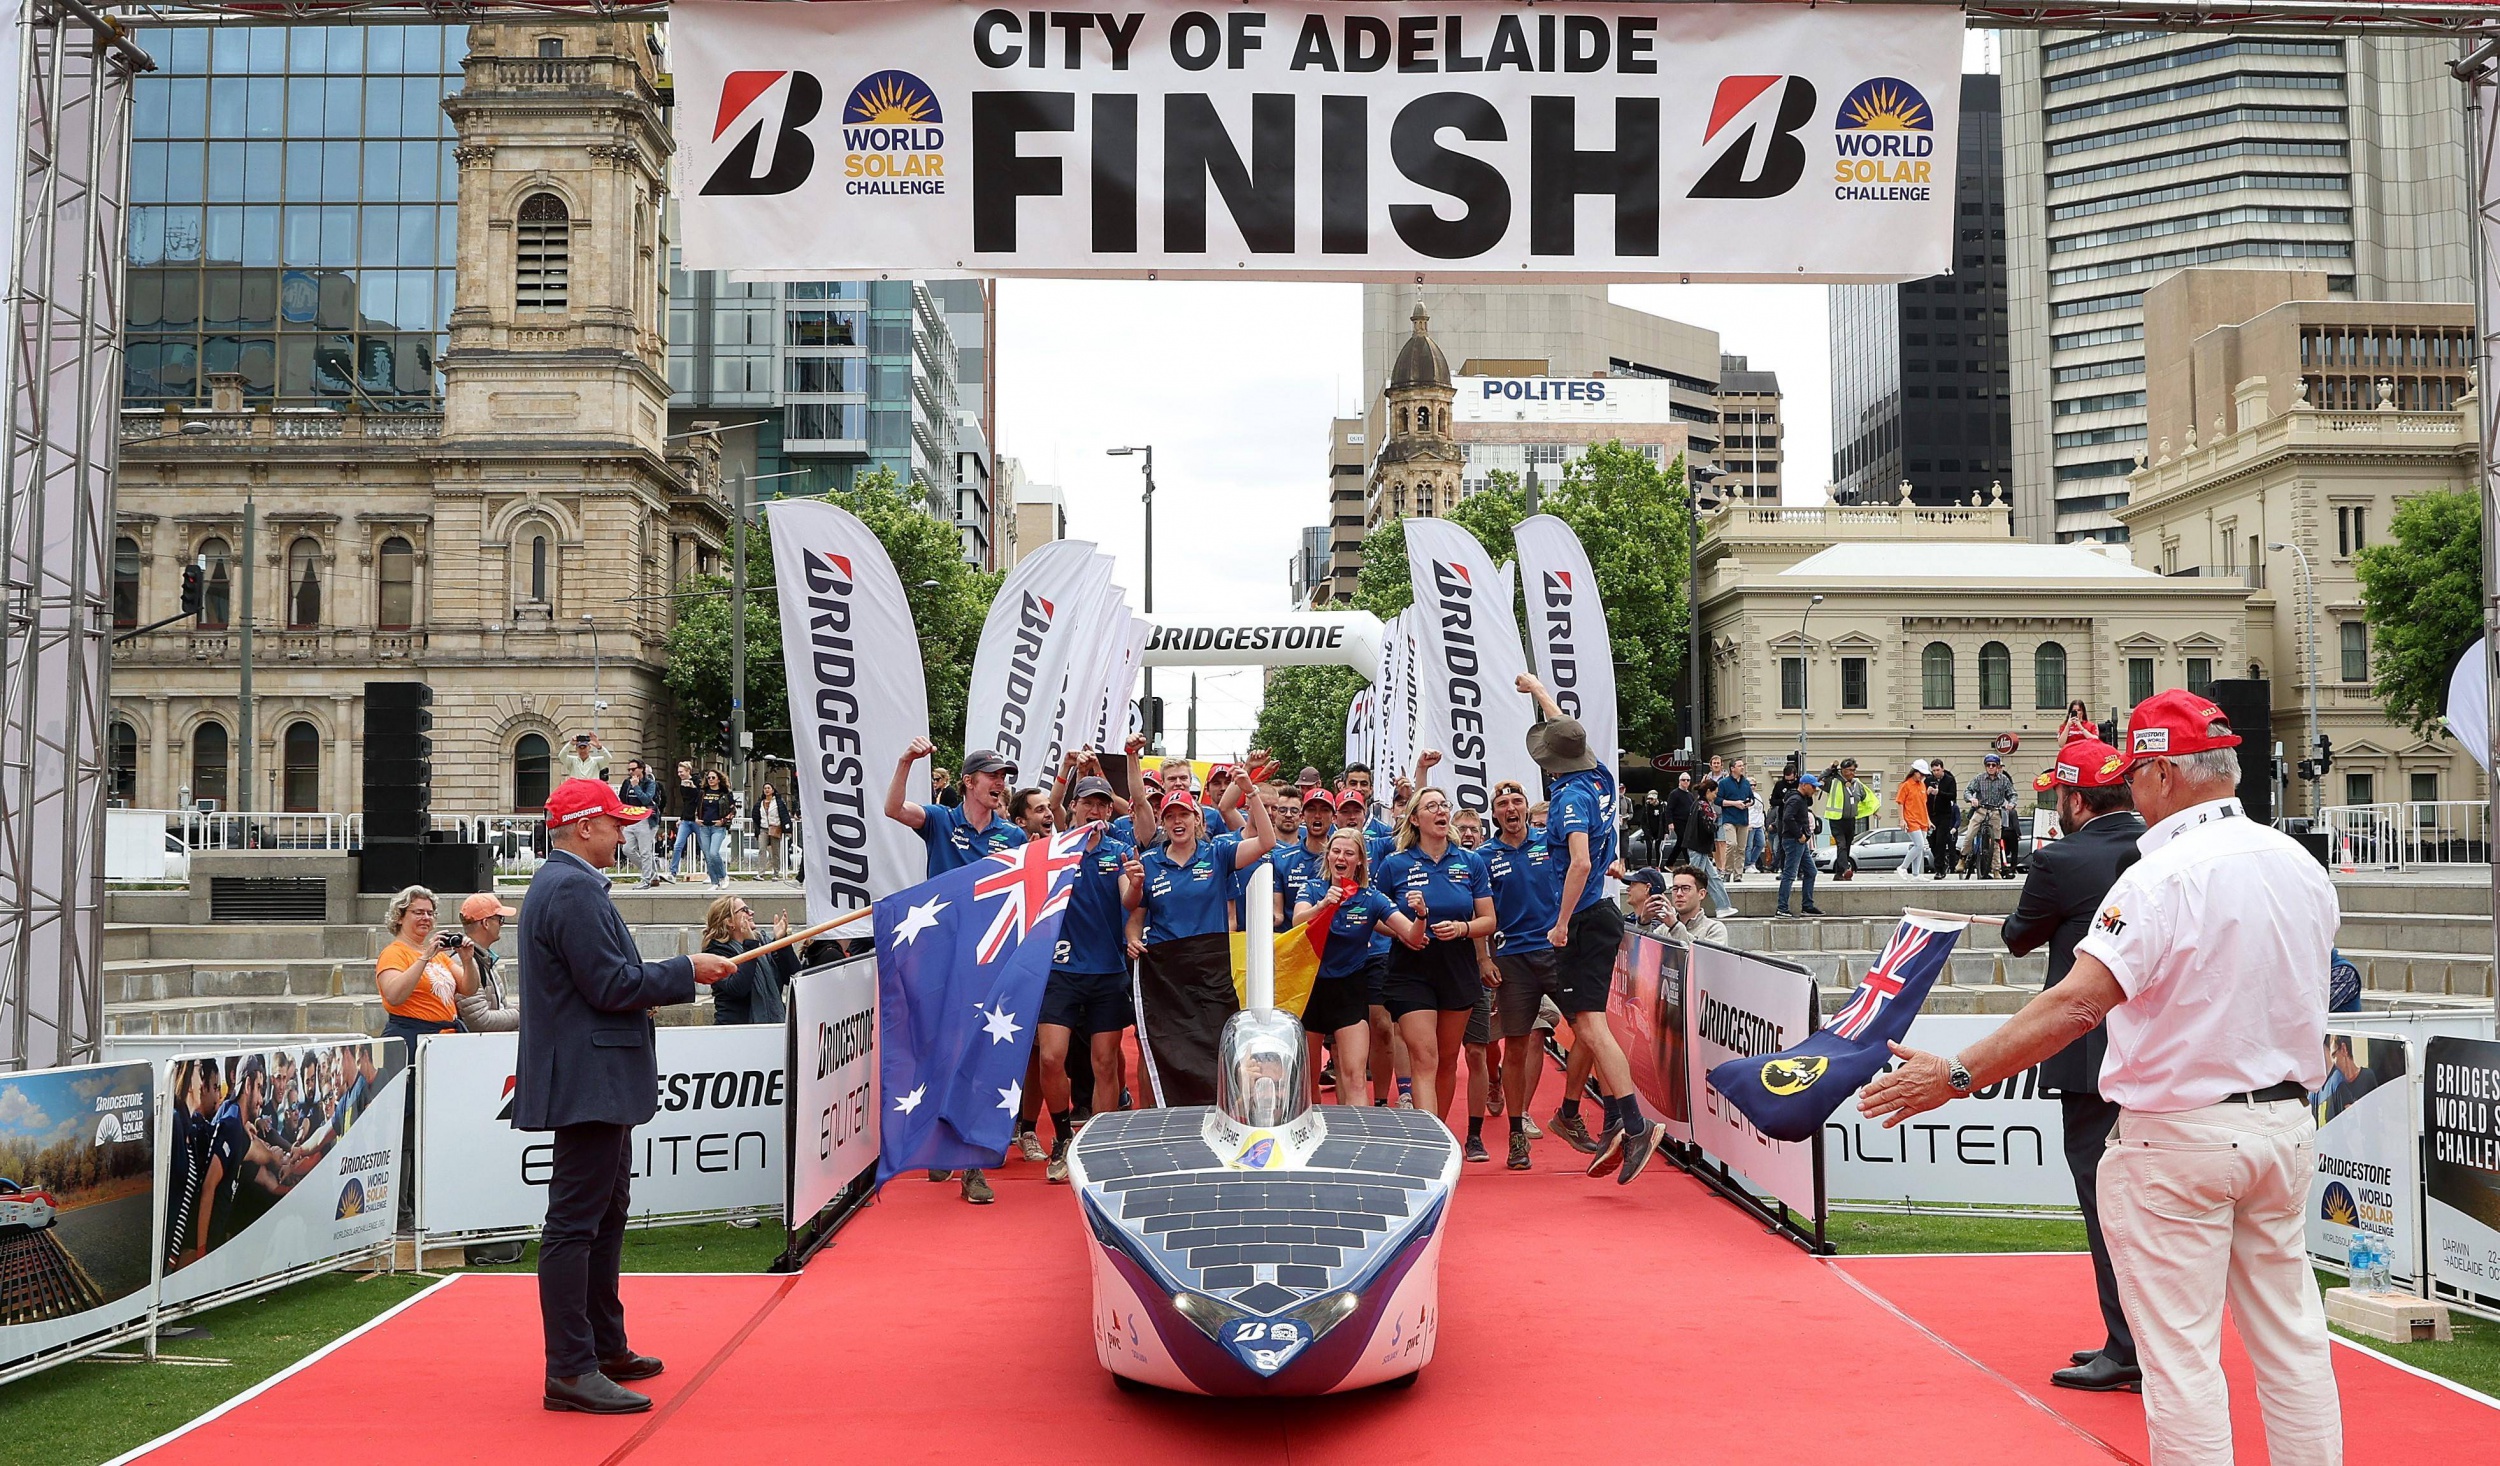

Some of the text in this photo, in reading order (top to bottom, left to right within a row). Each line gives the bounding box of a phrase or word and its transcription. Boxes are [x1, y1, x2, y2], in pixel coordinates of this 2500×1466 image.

[973, 8, 1658, 74] CITY OF ADELAIDE
[844, 128, 944, 152] WORLD
[1835, 134, 1934, 158] WORLD
[844, 154, 944, 178] SOLAR
[971, 90, 1660, 260] FINISH
[1834, 159, 1932, 184] SOLAR
[845, 180, 945, 196] CHALLENGE
[1834, 187, 1931, 202] CHALLENGE
[1482, 380, 1606, 401] POLITES
[1145, 624, 1344, 650] BRIDGESTONE
[803, 547, 874, 910] BRIDGESTONE
[1699, 989, 1784, 1058] BRIDGESTONE
[817, 1007, 875, 1081] BRIDGESTONE
[95, 1092, 144, 1112] BRIDGESTONE
[122, 1110, 144, 1123] WORLD
[820, 1082, 871, 1161] ENLITEN
[2436, 1097, 2487, 1134] WORLD
[122, 1121, 144, 1135] SOLAR
[339, 1149, 392, 1176] BRIDGESTONE
[2318, 1153, 2392, 1186] BRIDGESTONE
[367, 1171, 390, 1189] WORLD
[366, 1186, 388, 1203] SOLAR
[2358, 1187, 2393, 1208] WORLD
[365, 1200, 387, 1214] CHALLENGE
[2360, 1204, 2394, 1226] SOLAR
[2360, 1221, 2395, 1238] CHALLENGE
[2442, 1238, 2470, 1257] DARWIN
